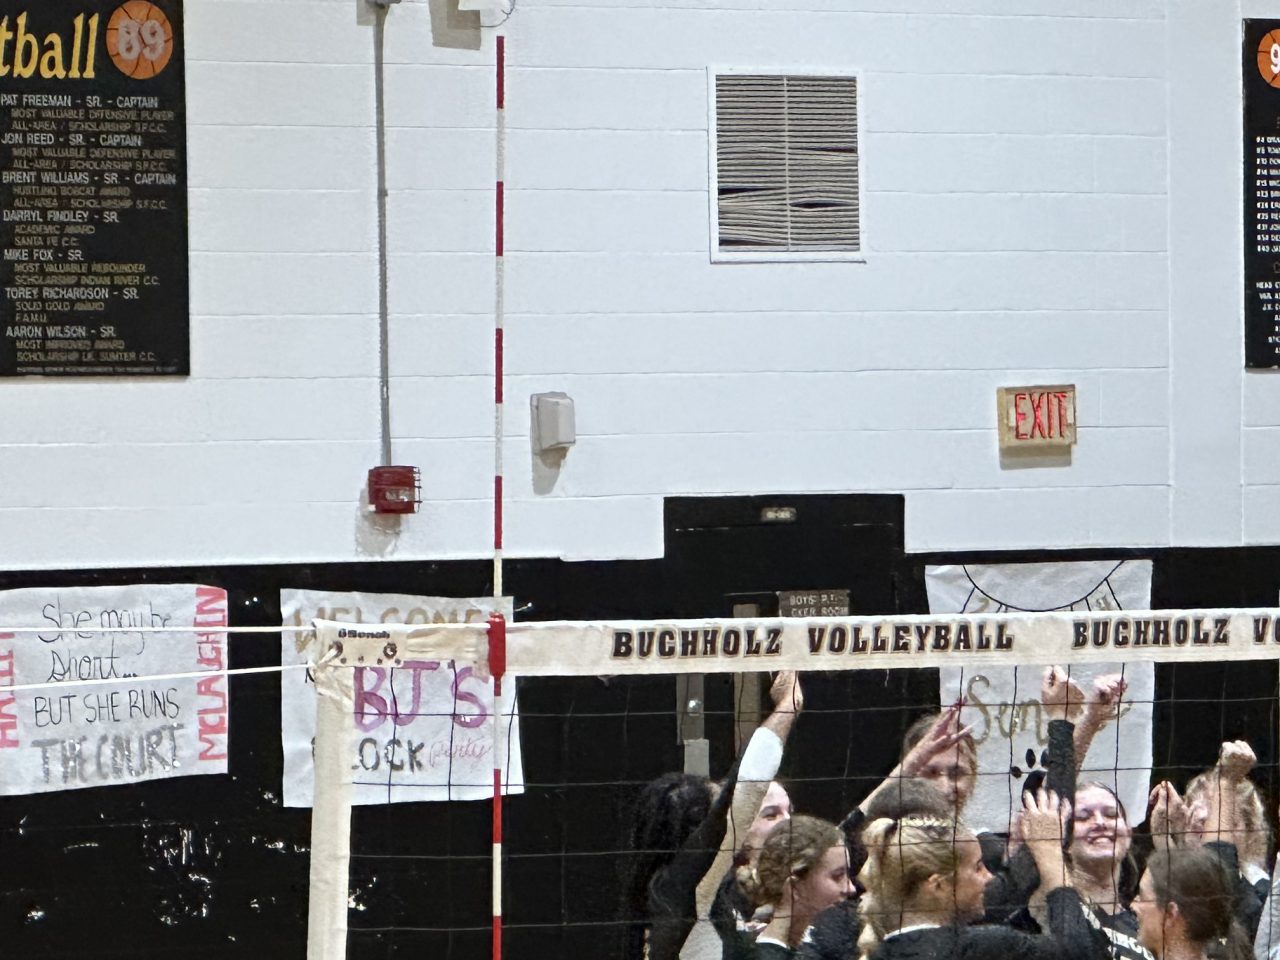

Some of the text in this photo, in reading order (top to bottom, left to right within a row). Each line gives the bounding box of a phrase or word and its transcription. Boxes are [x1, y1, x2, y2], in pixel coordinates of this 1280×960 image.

[119, 19, 164, 60] 89
[23, 95, 71, 107] FREEMAN
[117, 96, 158, 108] CAPTAIN
[1, 133, 23, 145] JON
[27, 133, 54, 145] REED
[100, 135, 141, 146] CAPTAIN
[3, 172, 36, 184] BRENT
[135, 173, 176, 185] CAPTAIN
[4, 249, 28, 261] MIKE
[33, 249, 53, 261] FOX
[43, 288, 108, 299] RICHARDSON
[6, 326, 42, 337] AARON
[46, 326, 86, 337] WILSON
[1015, 391, 1067, 440] EXIT
[37, 592, 93, 643] She
[100, 609, 145, 655] may
[611, 626, 783, 660] BUCHHOLZ
[807, 622, 1015, 657] VOLLEYBALL
[1072, 616, 1231, 649] BUCHHOLZ
[34, 688, 180, 727] BUT SHE RUNS
